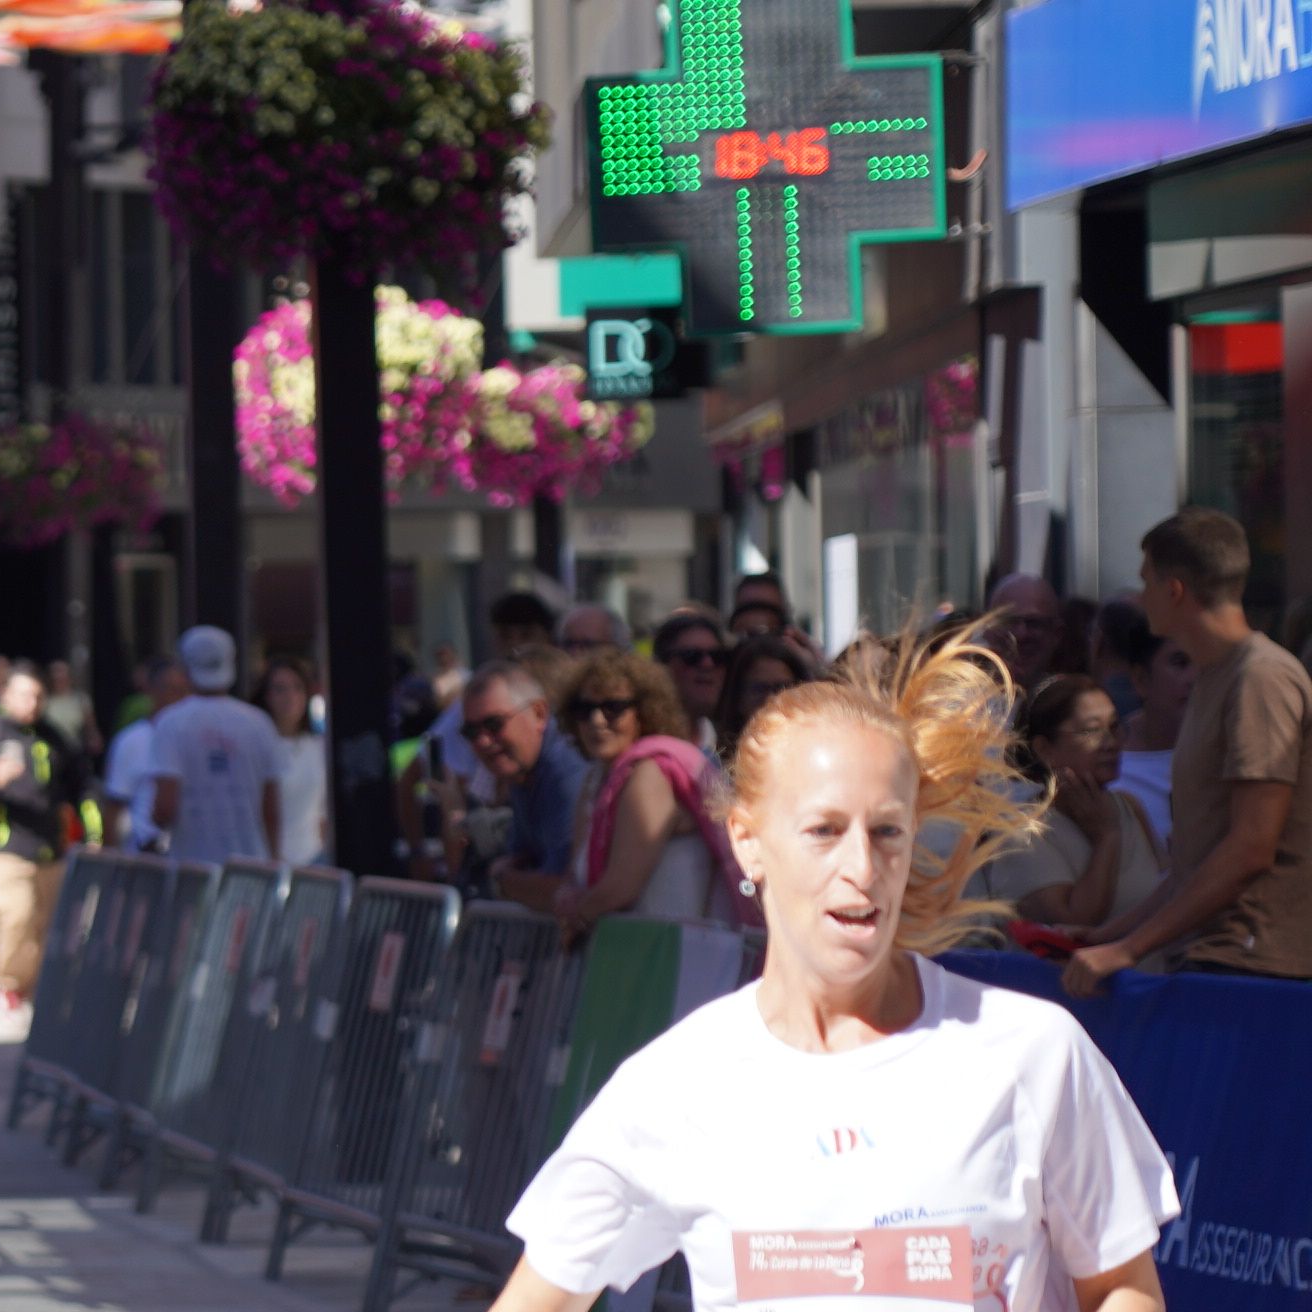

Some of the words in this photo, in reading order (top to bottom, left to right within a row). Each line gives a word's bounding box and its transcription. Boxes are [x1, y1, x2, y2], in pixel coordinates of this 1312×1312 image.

[874, 1206, 929, 1228] MORA
[749, 1234, 797, 1250] MORA
[905, 1235, 952, 1250] CADA
[906, 1249, 952, 1266] PAS
